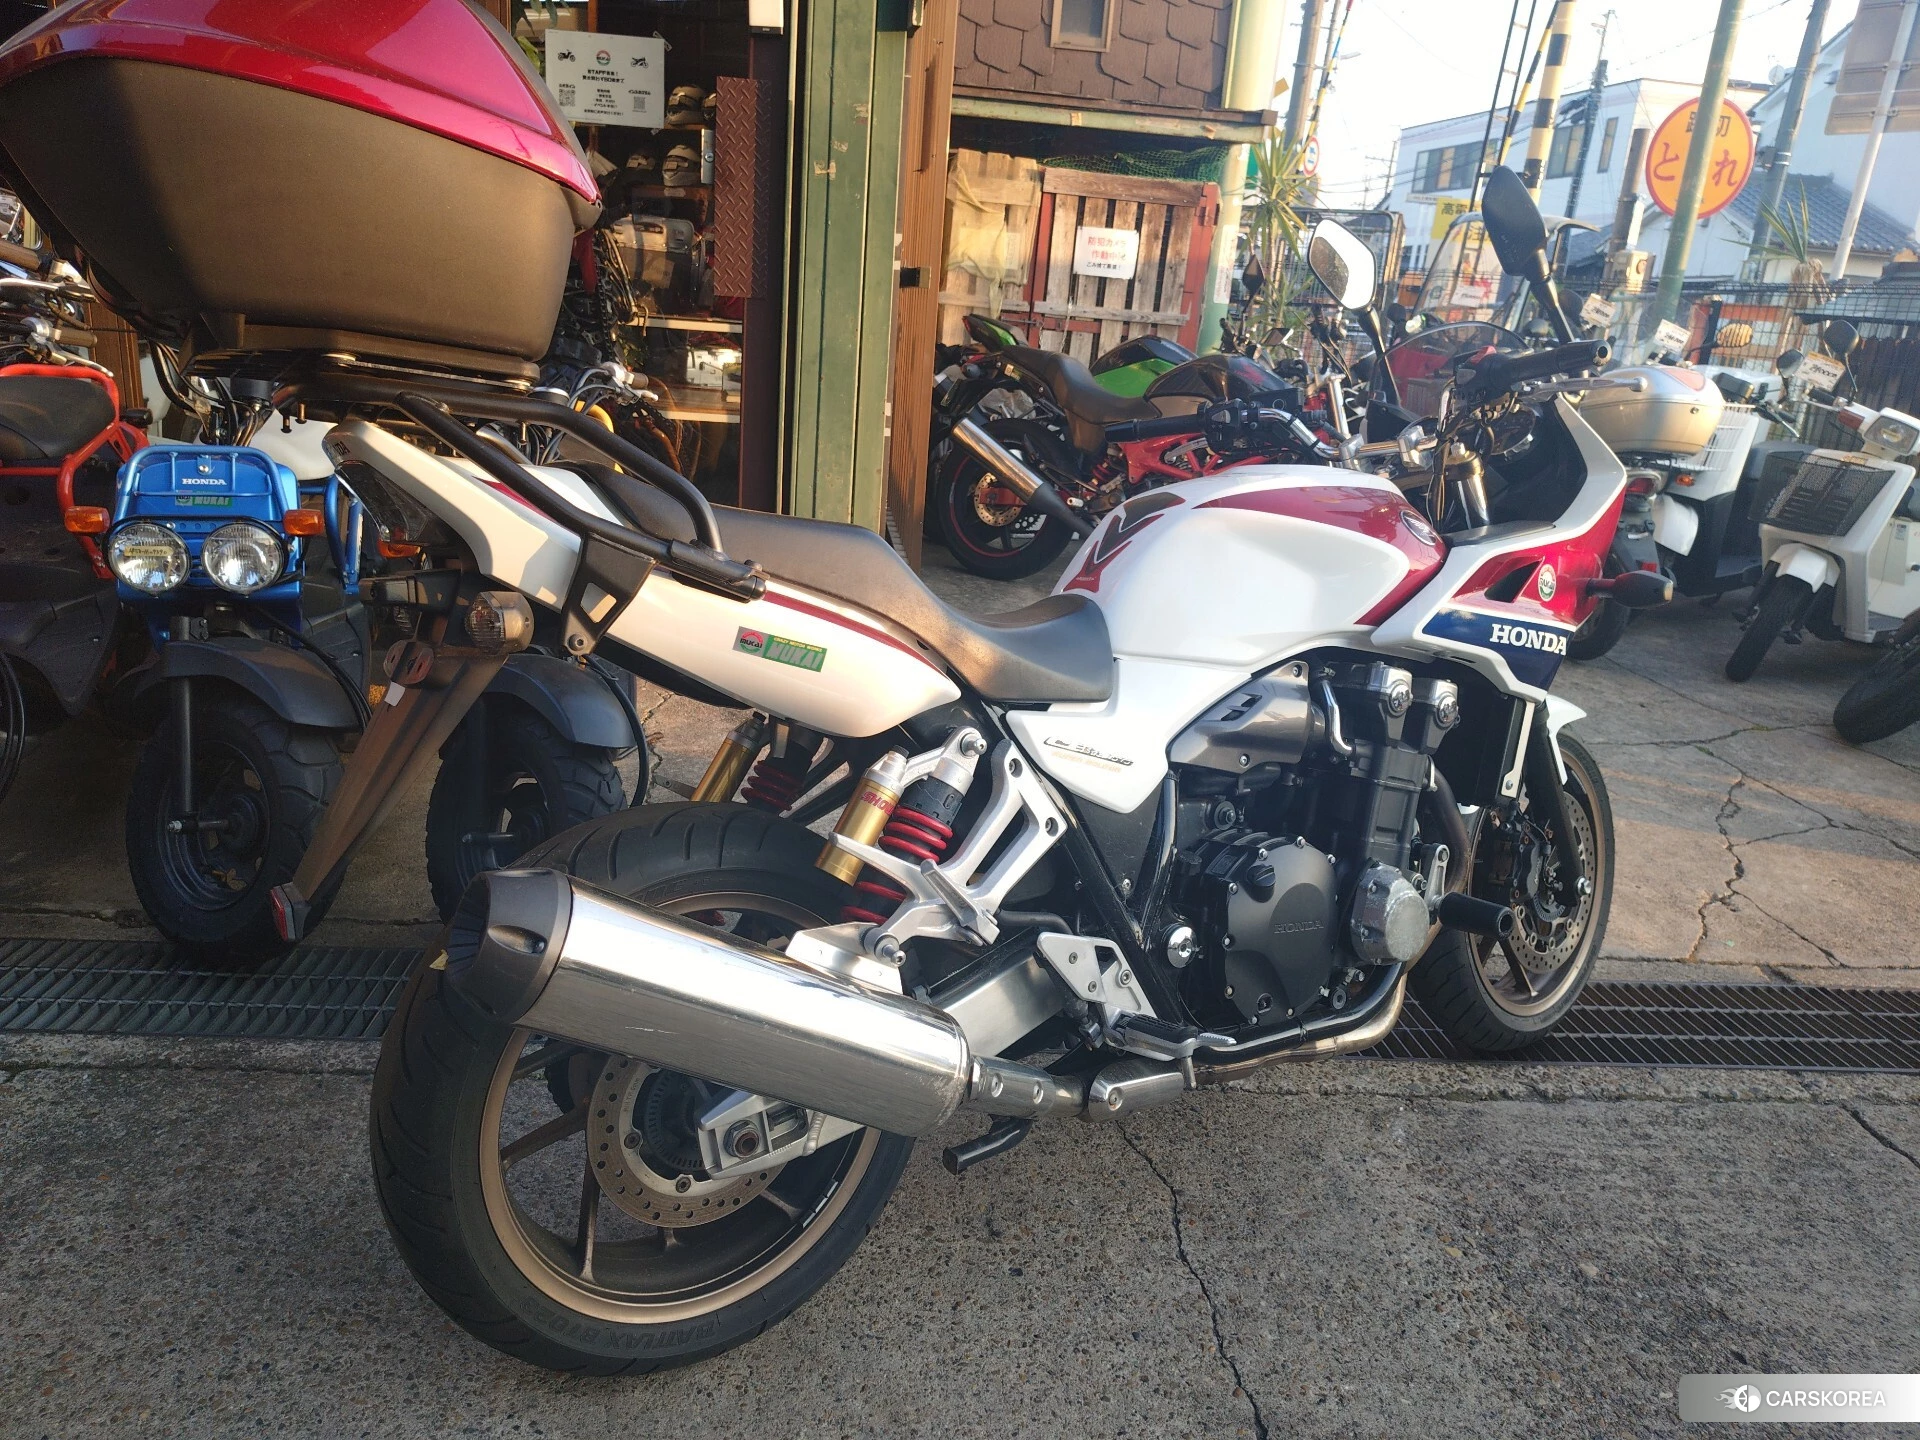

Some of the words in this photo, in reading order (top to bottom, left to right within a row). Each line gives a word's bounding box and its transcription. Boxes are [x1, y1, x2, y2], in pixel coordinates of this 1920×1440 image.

[1653, 142, 1738, 187] とれ
[181, 477, 227, 486] HONDA
[1489, 623, 1567, 656] HONDA
[765, 641, 824, 669] MUKAI
[1274, 920, 1325, 934] HONDA
